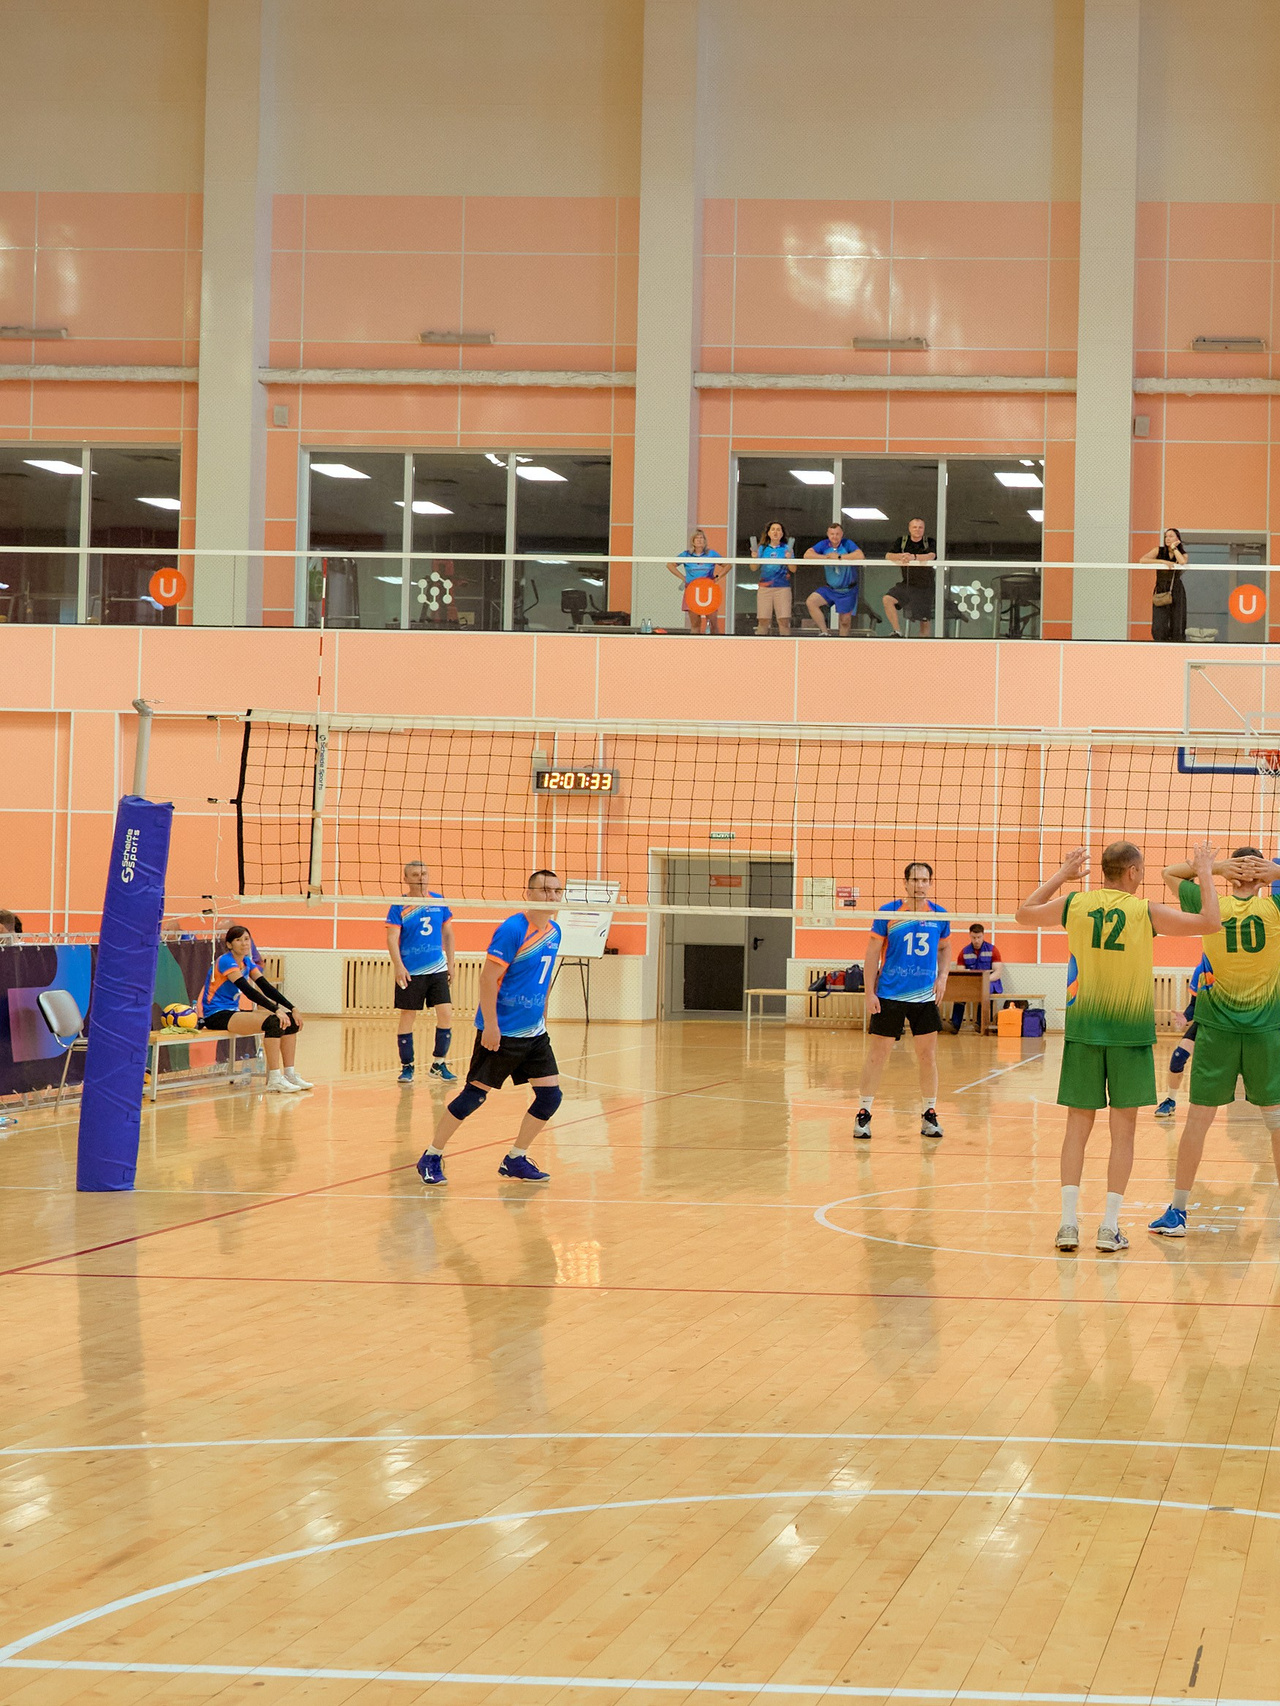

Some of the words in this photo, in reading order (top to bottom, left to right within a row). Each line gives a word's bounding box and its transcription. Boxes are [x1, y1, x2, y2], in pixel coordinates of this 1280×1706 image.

[160, 578, 177, 598] U
[695, 587, 713, 607] U
[1239, 595, 1257, 615] U
[543, 772, 612, 790] 12:07:33
[128, 829, 140, 868] Sports
[419, 916, 433, 936] 3
[1087, 906, 1127, 952] 12
[1221, 914, 1266, 954] 10
[903, 931, 930, 957] 13
